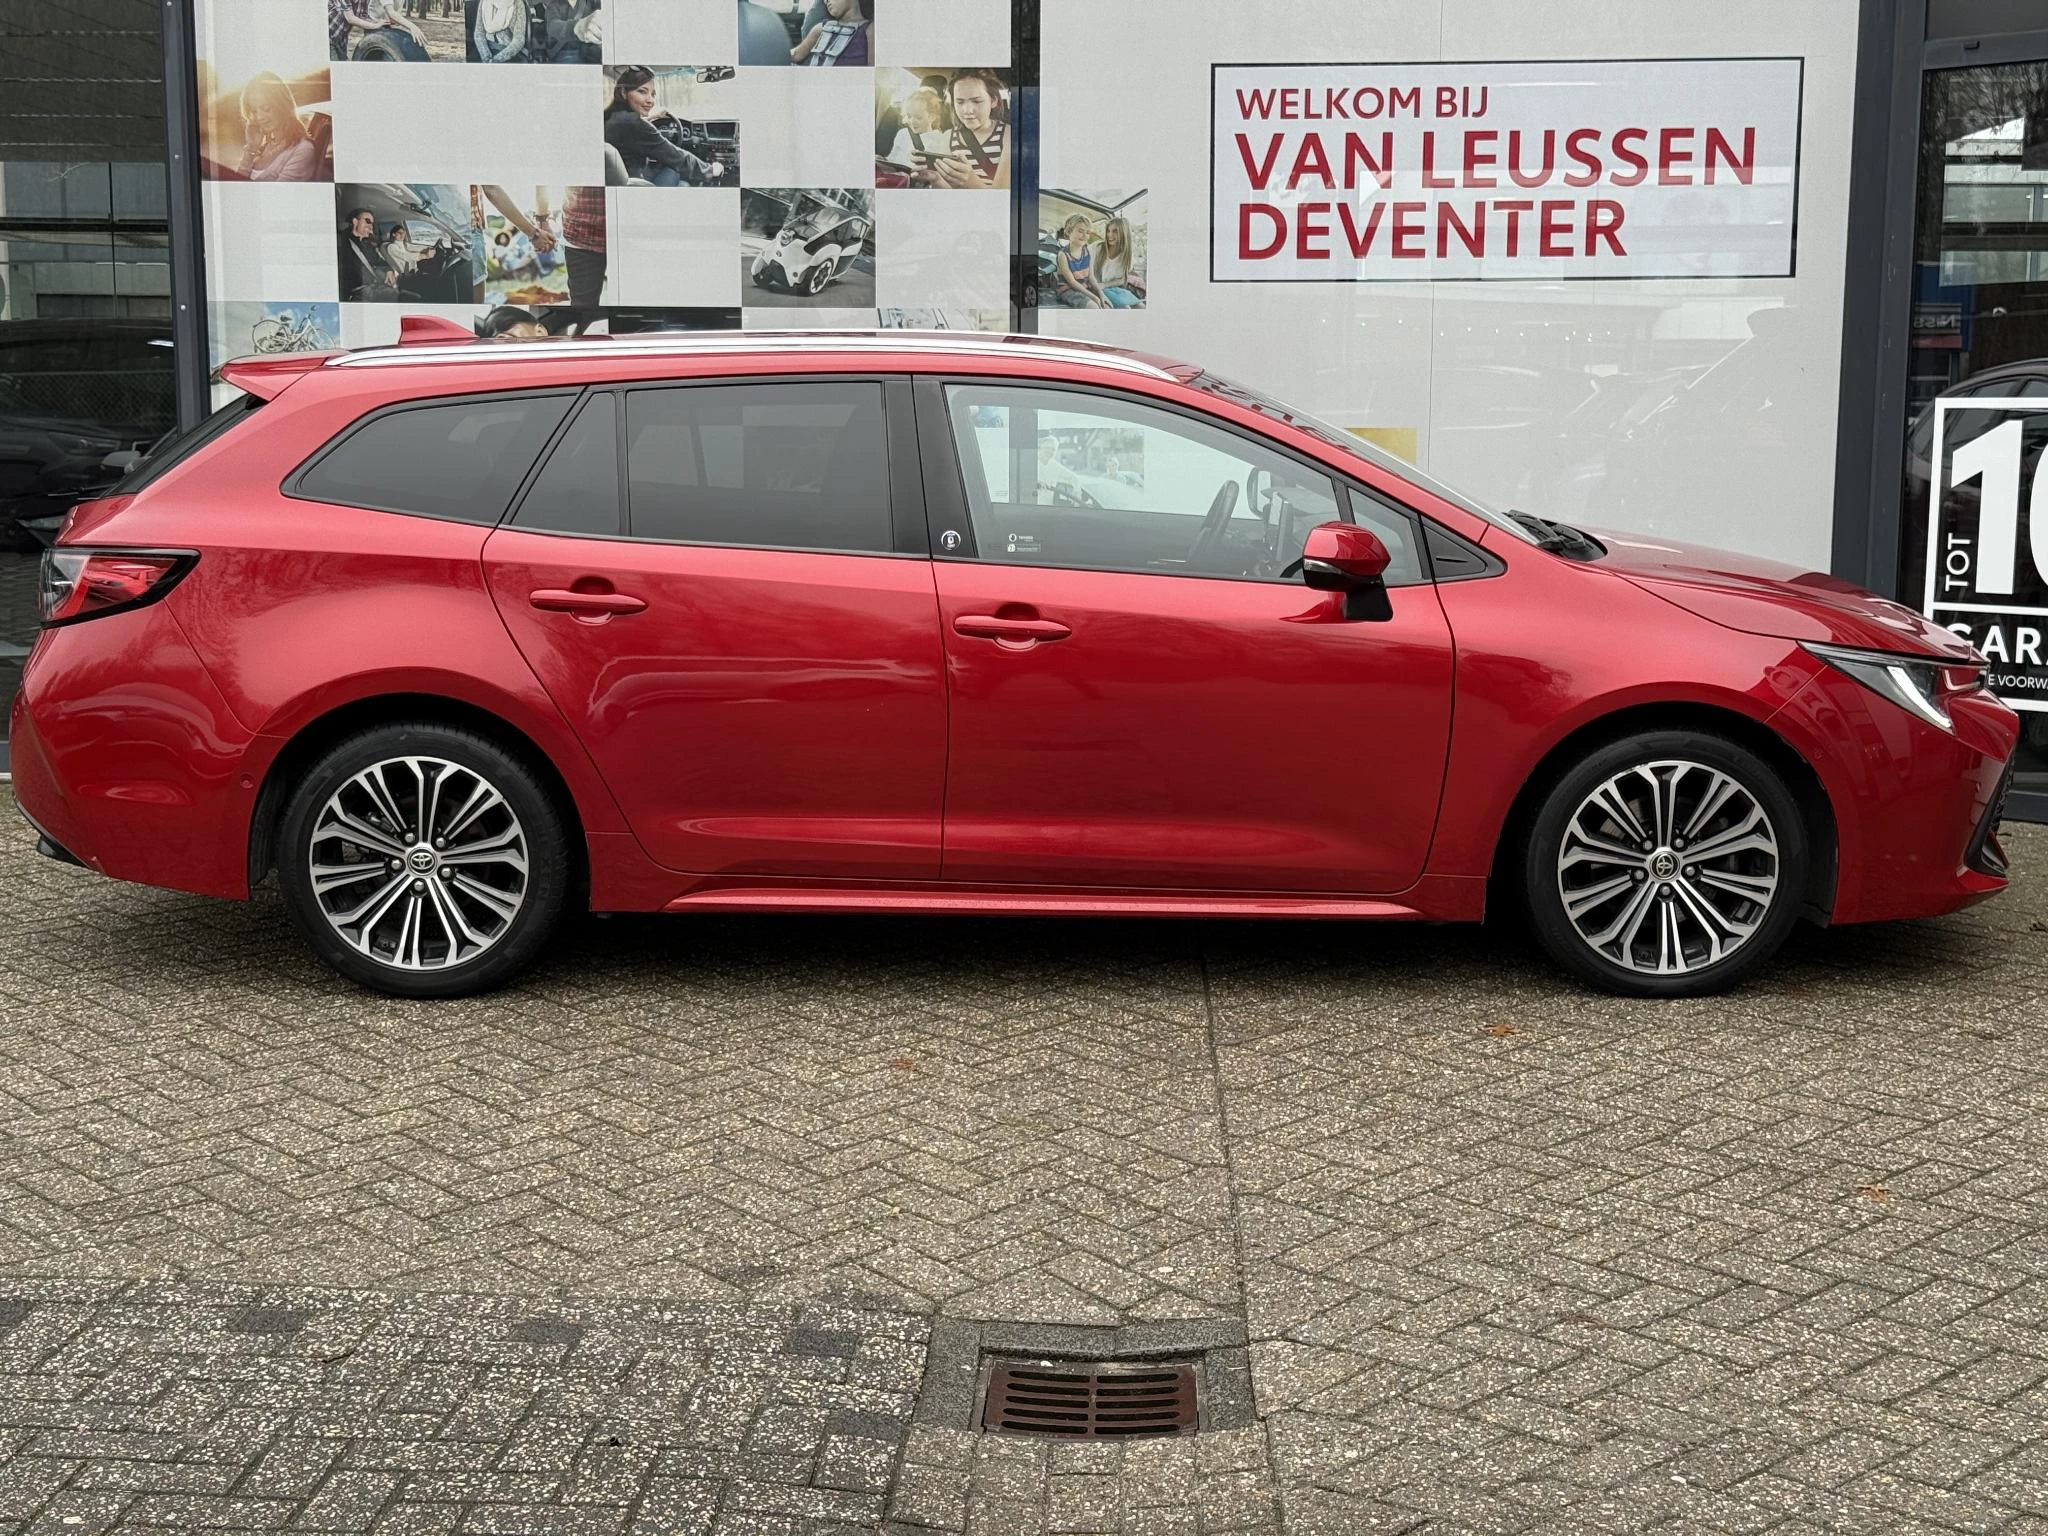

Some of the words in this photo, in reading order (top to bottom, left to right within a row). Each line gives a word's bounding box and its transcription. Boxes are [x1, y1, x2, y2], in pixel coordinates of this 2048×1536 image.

[1237, 87, 1421, 120] WELKOM
[1436, 87, 1489, 118] BIJ
[1235, 131, 1393, 190] VAN
[1422, 127, 1756, 189] LEUSSEN
[1237, 199, 1627, 260] DEVENTER
[1945, 532, 1972, 592] TOT
[1997, 675, 2048, 689] VOORW
